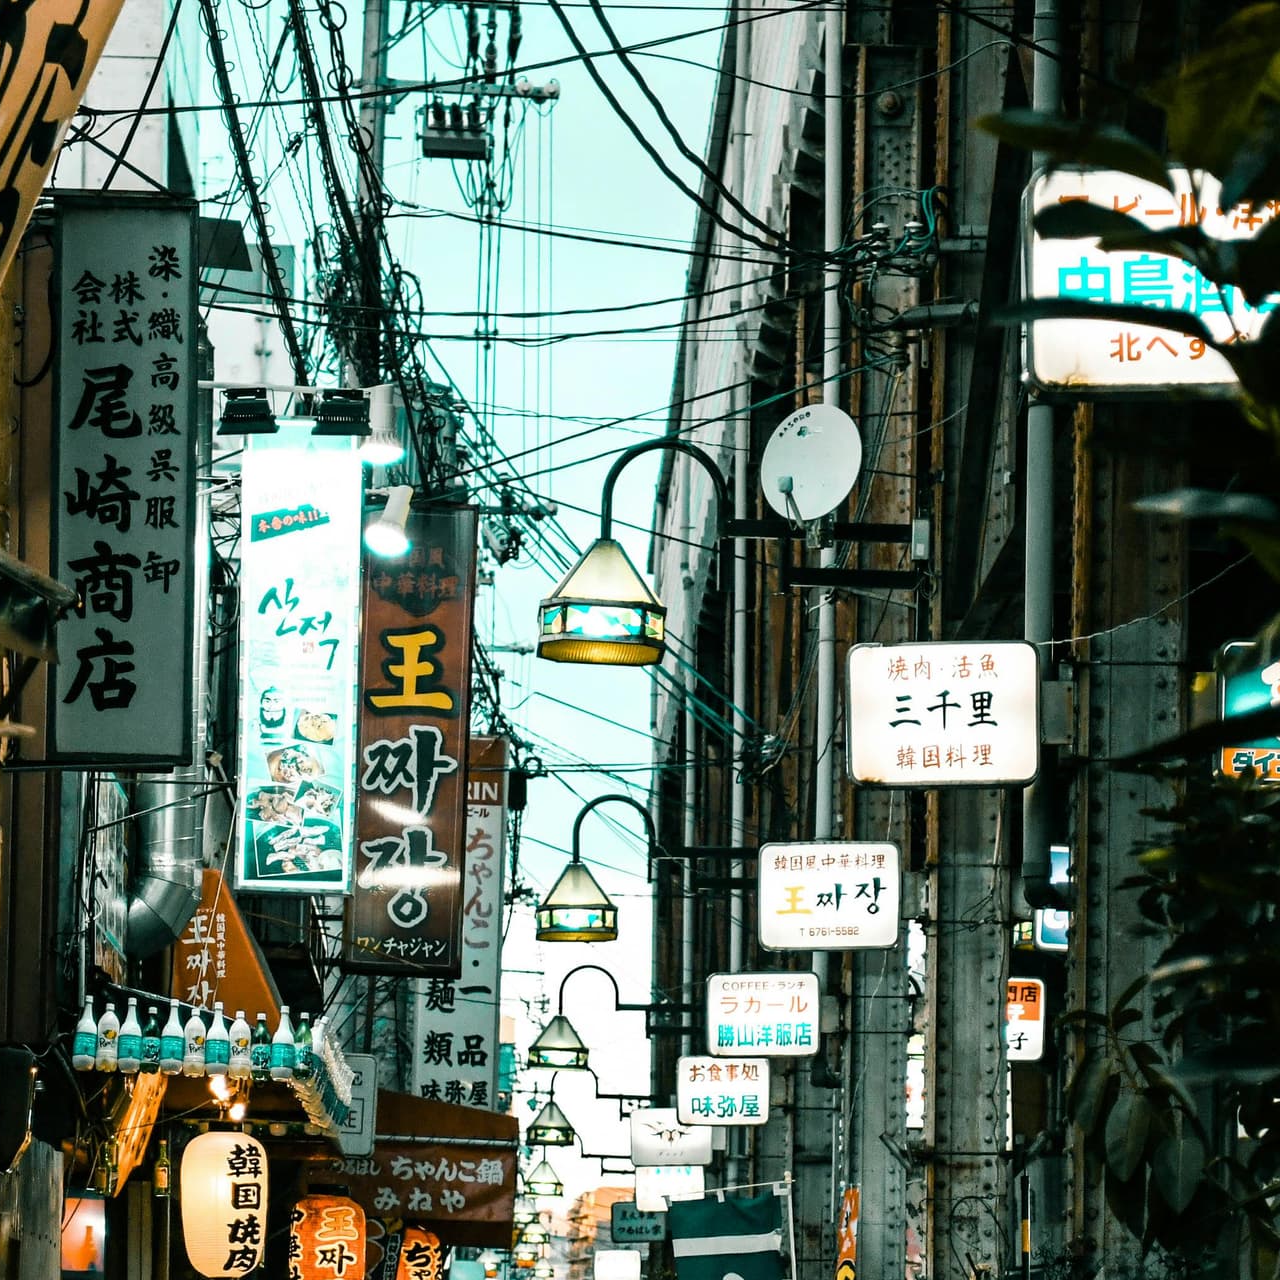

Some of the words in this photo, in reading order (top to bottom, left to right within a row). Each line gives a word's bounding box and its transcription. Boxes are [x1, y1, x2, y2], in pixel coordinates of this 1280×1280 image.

[63, 363, 144, 712] 尾崎商店
[258, 577, 340, 671] 산적
[887, 654, 999, 681] 焼肉・活魚
[889, 690, 999, 731] 三千里
[896, 744, 995, 770] 韓国料理
[774, 854, 886, 871] 韓国風中華料理
[776, 877, 888, 915] 王짜장
[809, 926, 860, 937] 6761-5582
[357, 936, 448, 959] ワンチャジャン
[720, 995, 808, 1014] ラカール
[717, 1022, 813, 1047] 勝山洋服店
[689, 1064, 760, 1082] お食事処
[421, 1079, 489, 1107] 味弥屋
[691, 1095, 761, 1118] 味弥屋
[391, 1156, 504, 1185] ちゃんこ鍋
[227, 1143, 264, 1273] 韓国焼肉
[373, 1187, 467, 1214] みねや
